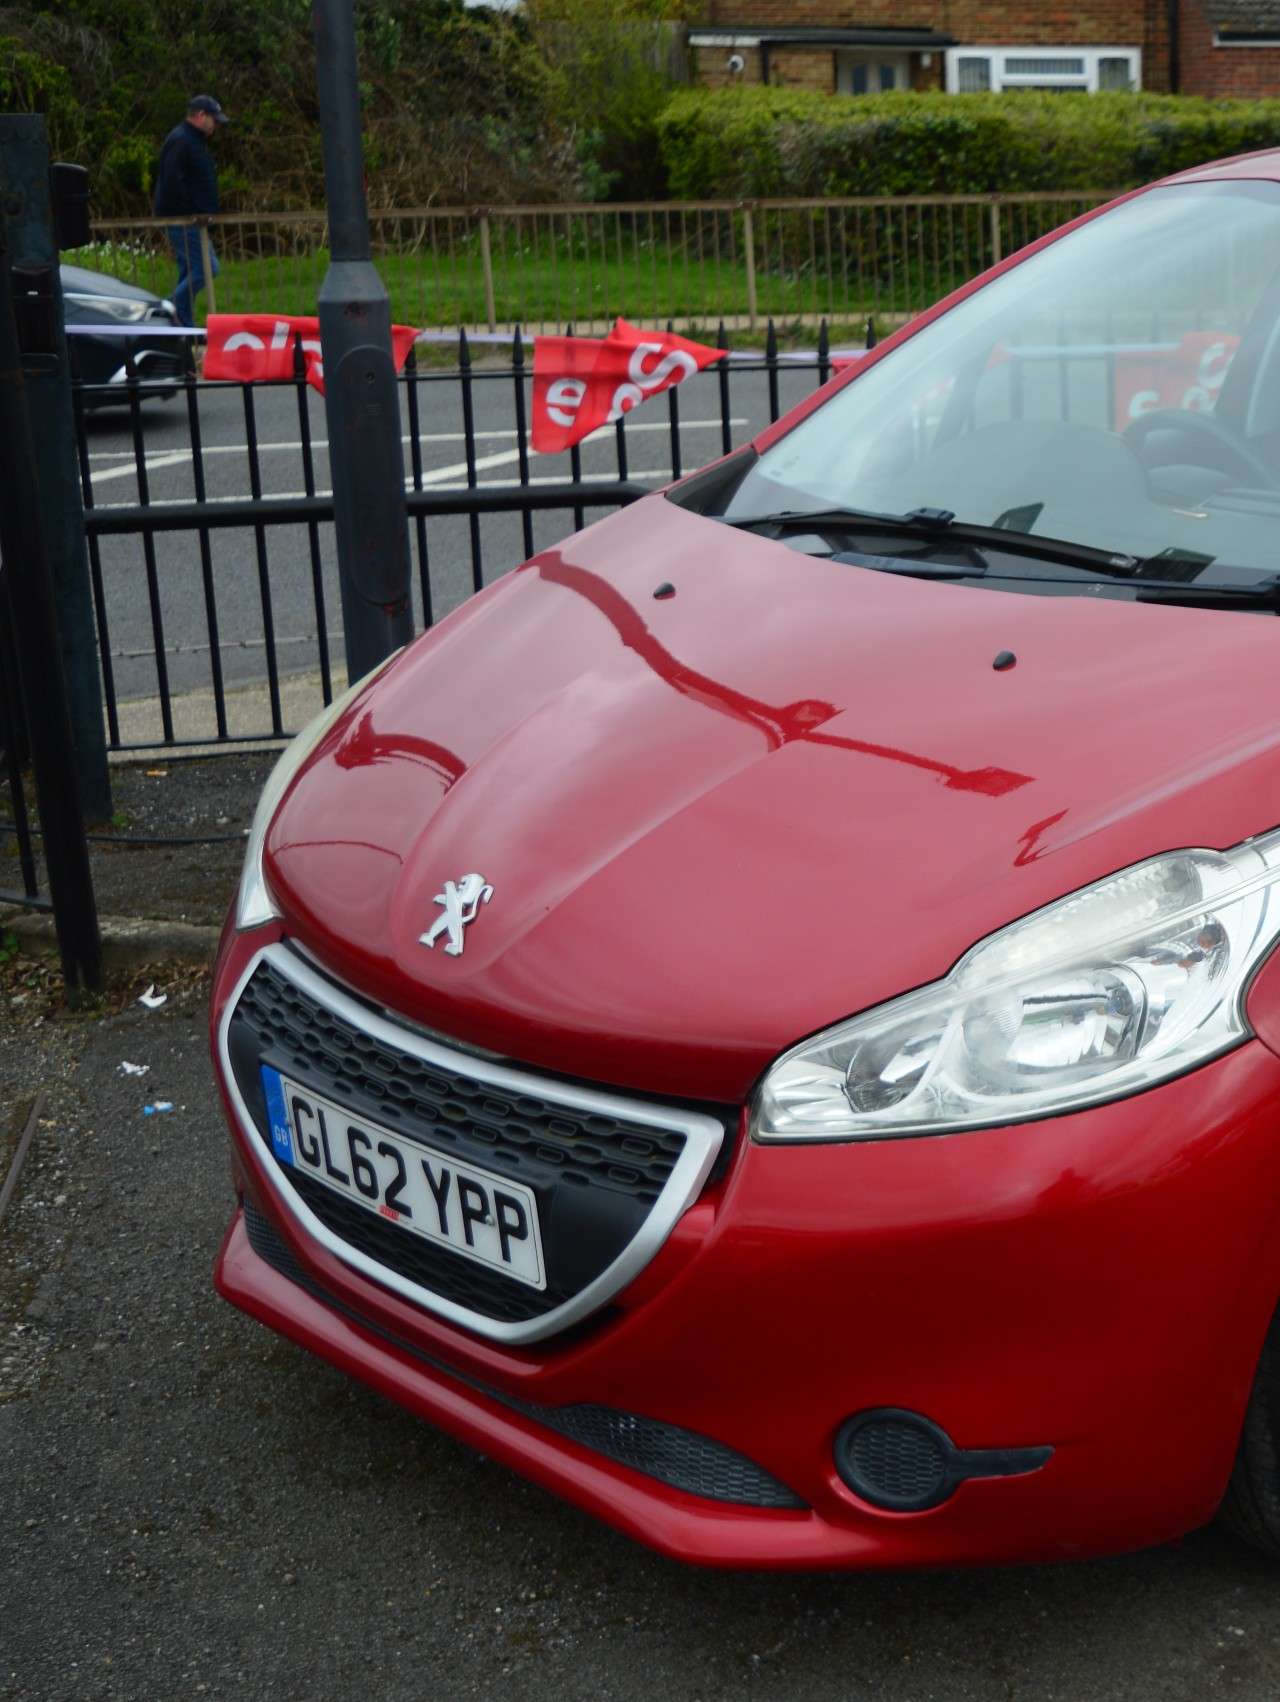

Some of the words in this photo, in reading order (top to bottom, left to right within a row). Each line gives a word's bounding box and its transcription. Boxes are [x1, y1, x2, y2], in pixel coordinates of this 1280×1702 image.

[274, 1124, 289, 1147] GB
[291, 1096, 413, 1219] GL62
[421, 1159, 529, 1263] YPP
